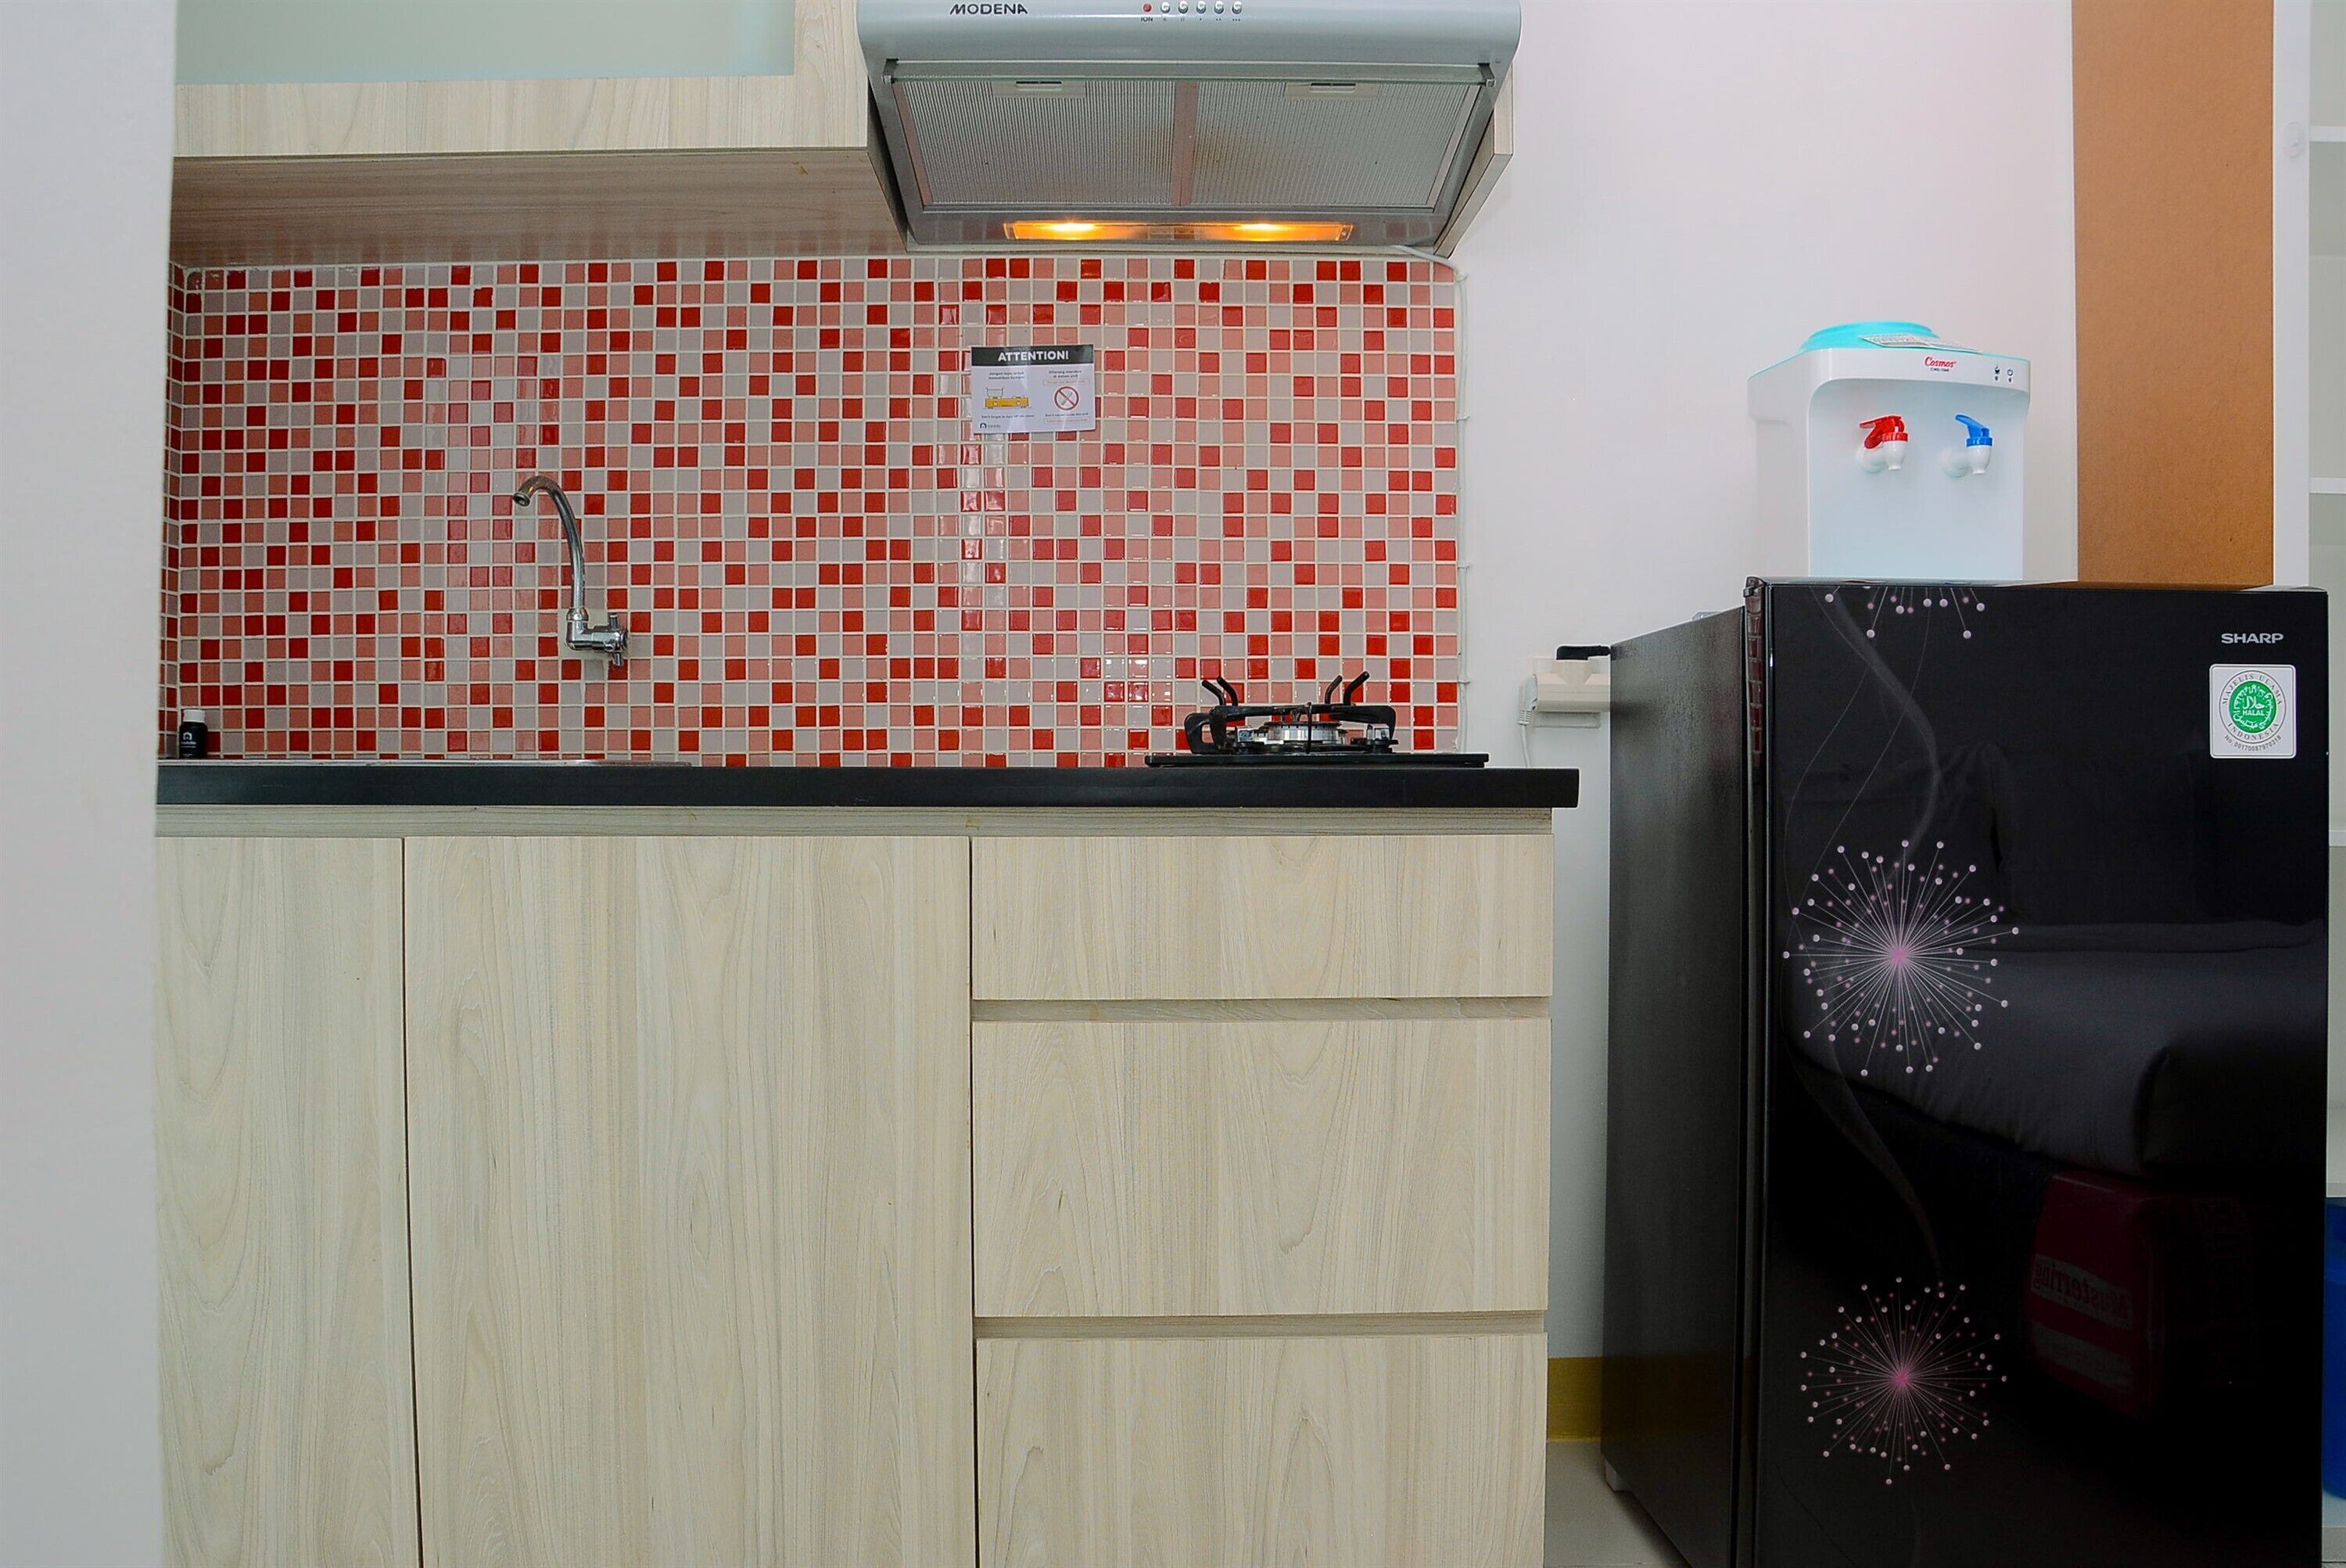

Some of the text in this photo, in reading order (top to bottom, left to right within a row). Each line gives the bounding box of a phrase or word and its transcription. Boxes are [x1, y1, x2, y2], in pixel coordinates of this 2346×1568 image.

[949, 3, 1028, 15] MODENA
[998, 350, 1069, 362] ATTENTION!
[1925, 357, 1954, 368] Cosmos
[2221, 633, 2284, 644] SHARP
[2222, 673, 2283, 705] MAJELIS ULAMA
[2227, 721, 2280, 741] INDONESIA
